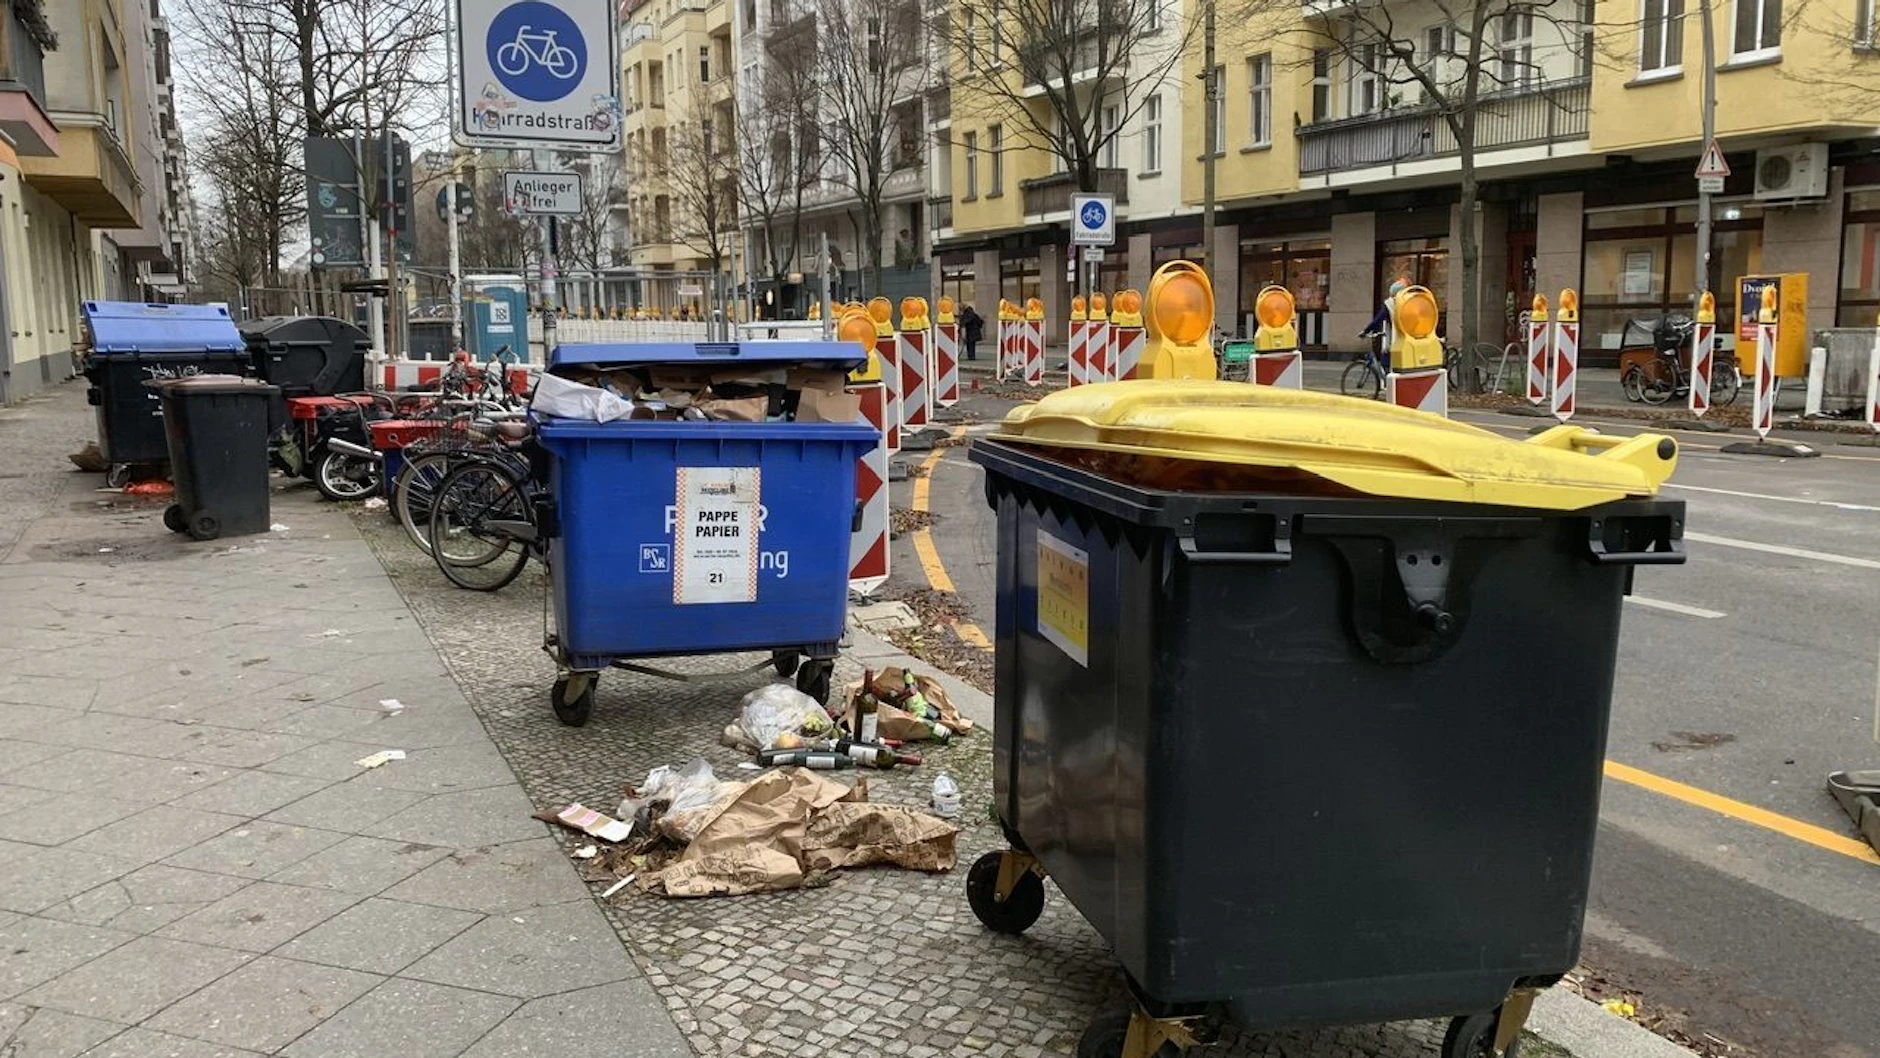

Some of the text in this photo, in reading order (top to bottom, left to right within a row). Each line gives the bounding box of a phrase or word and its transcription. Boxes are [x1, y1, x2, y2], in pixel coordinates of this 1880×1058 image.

[515, 180, 573, 197] Anlieger
[532, 193, 556, 207] frei
[699, 511, 738, 522] PAPPE
[695, 525, 740, 537] PAPIER
[709, 573, 724, 583] 21
